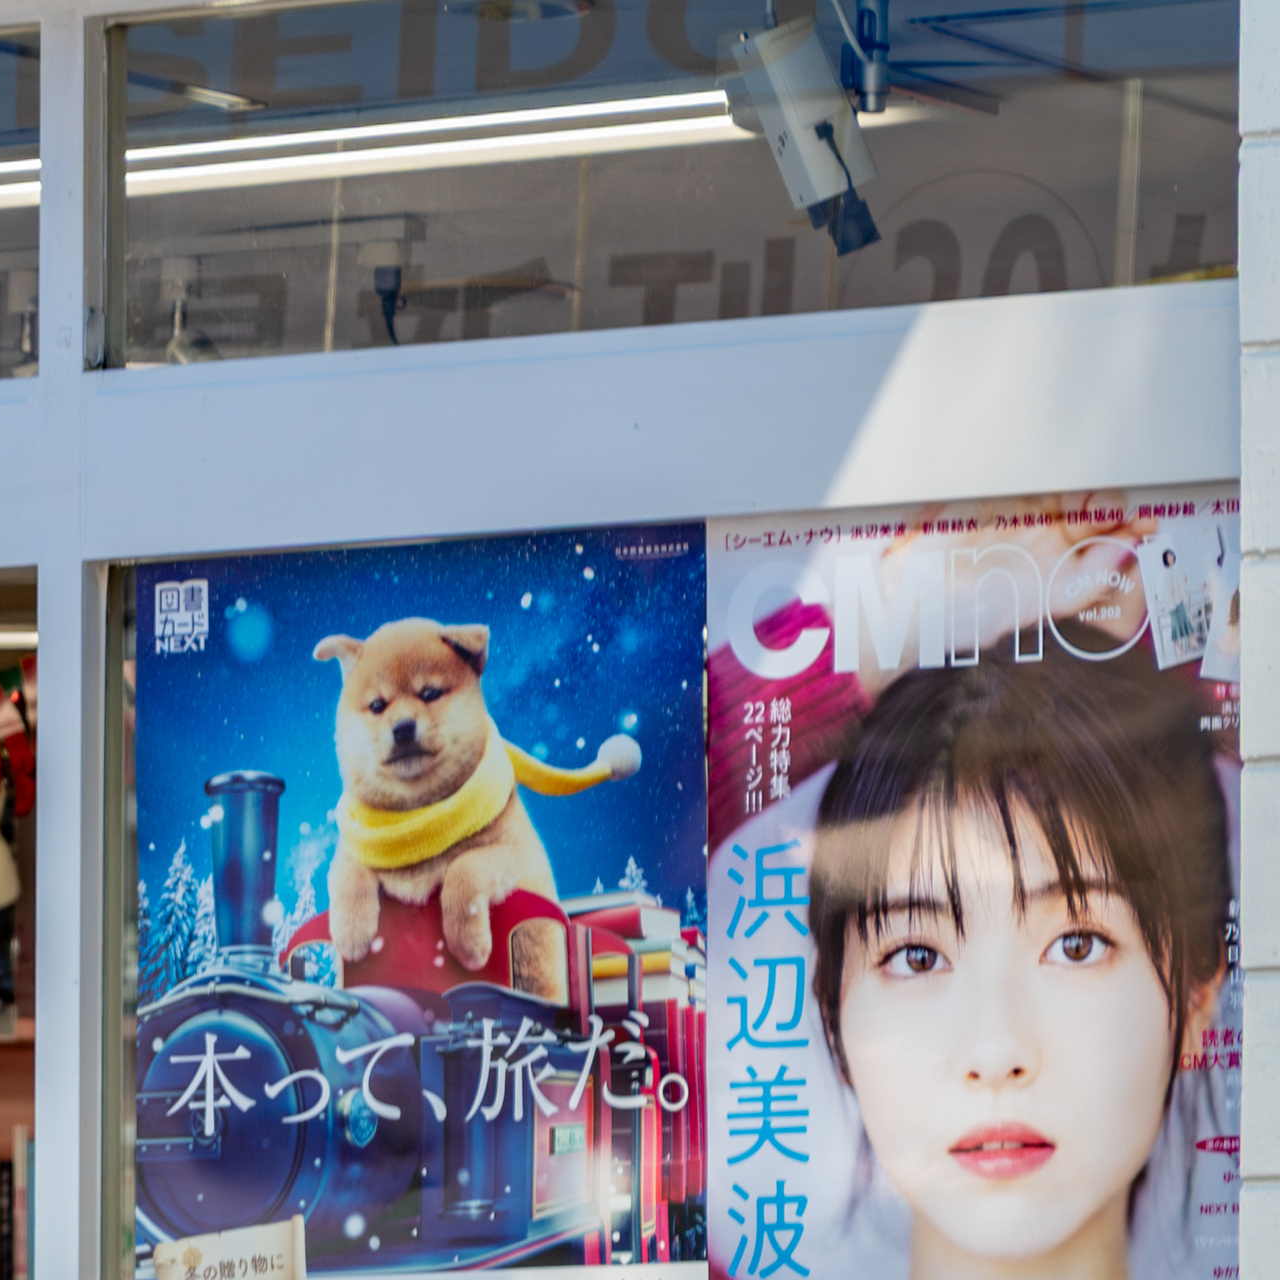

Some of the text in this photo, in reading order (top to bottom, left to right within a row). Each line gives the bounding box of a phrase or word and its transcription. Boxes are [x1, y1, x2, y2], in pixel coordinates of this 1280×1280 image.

[155, 635, 209, 655] NEXT
[770, 696, 792, 799] 総力特集
[167, 1014, 690, 1137] 本って、旅だ。
[726, 837, 811, 1280] 浜辺美波
